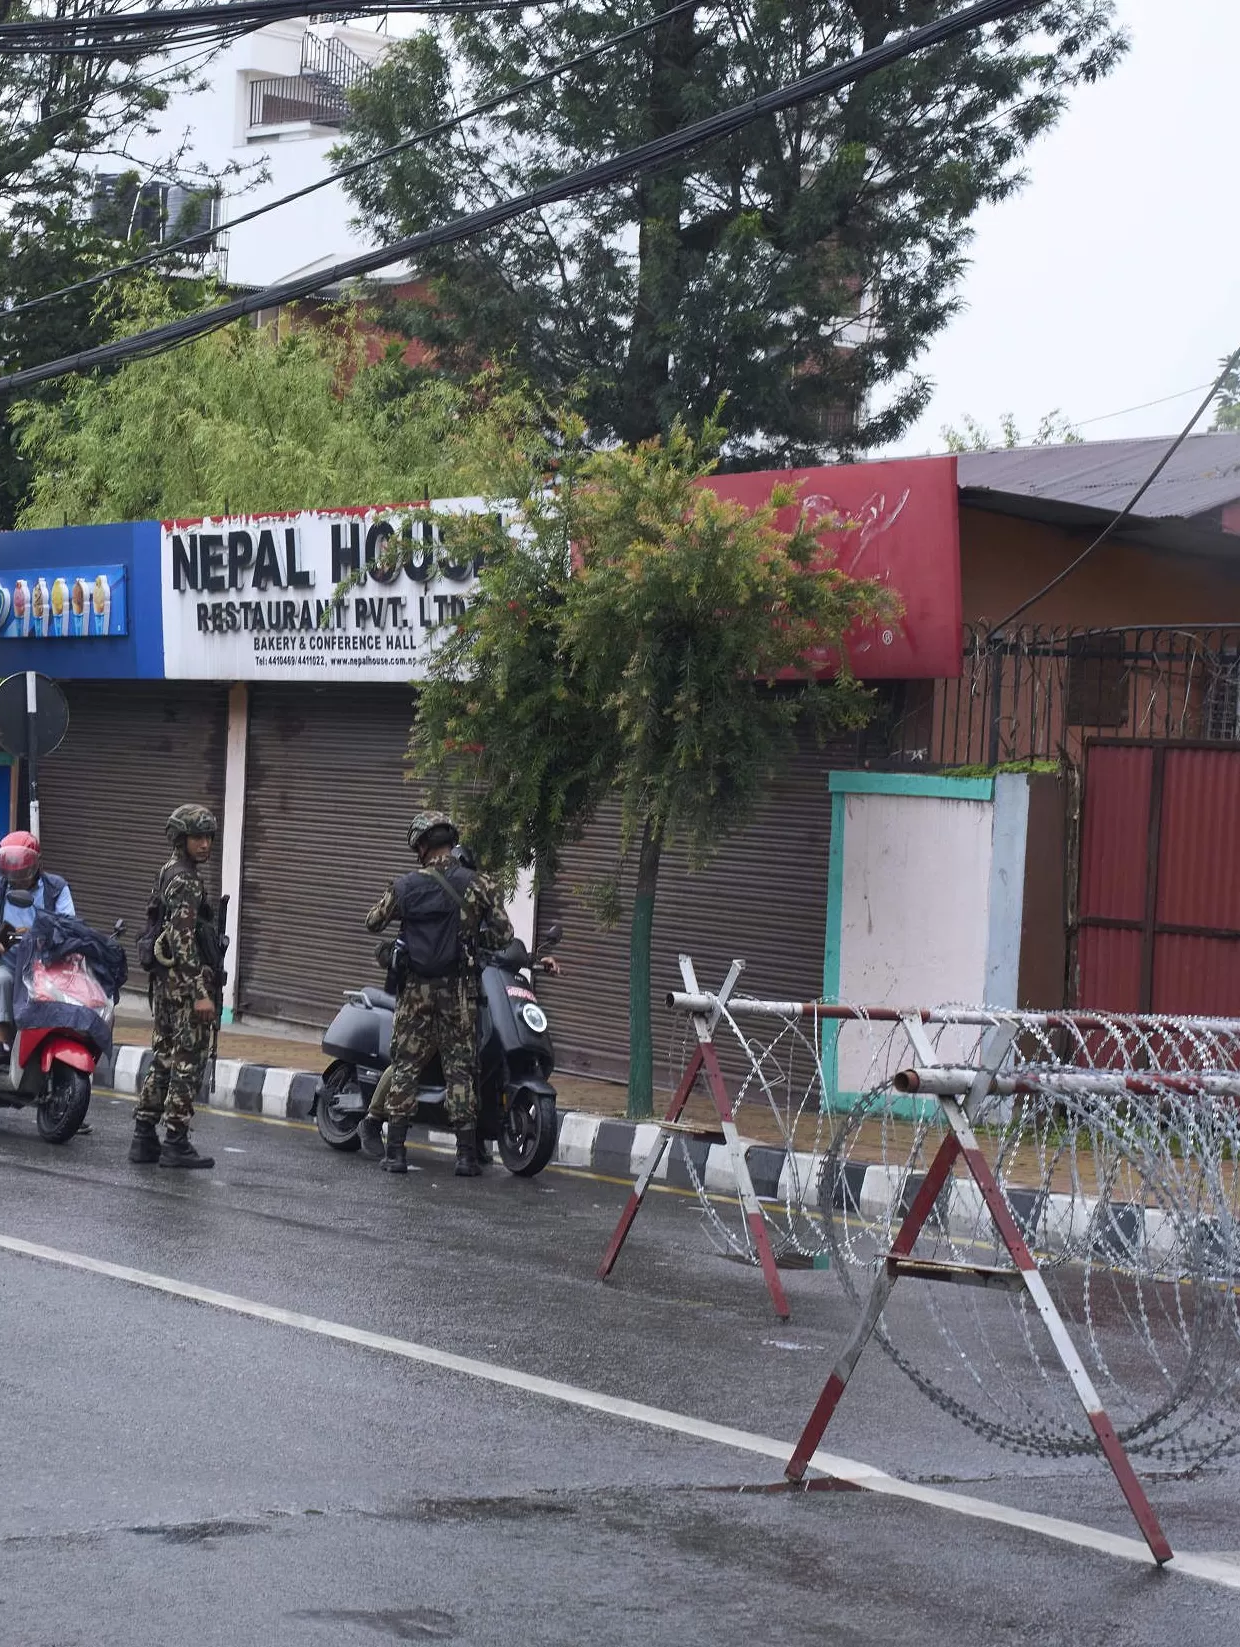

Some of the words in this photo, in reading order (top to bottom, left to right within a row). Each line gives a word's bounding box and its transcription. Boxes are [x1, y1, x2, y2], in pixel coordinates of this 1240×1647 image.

[172, 527, 313, 591] NEPAL
[196, 599, 345, 633] RESTAURANT
[355, 597, 409, 629] PVT.
[253, 636, 297, 651] BAKERY
[299, 636, 306, 650] &
[309, 635, 381, 650] CONFERENCE
[386, 635, 417, 650] HALL
